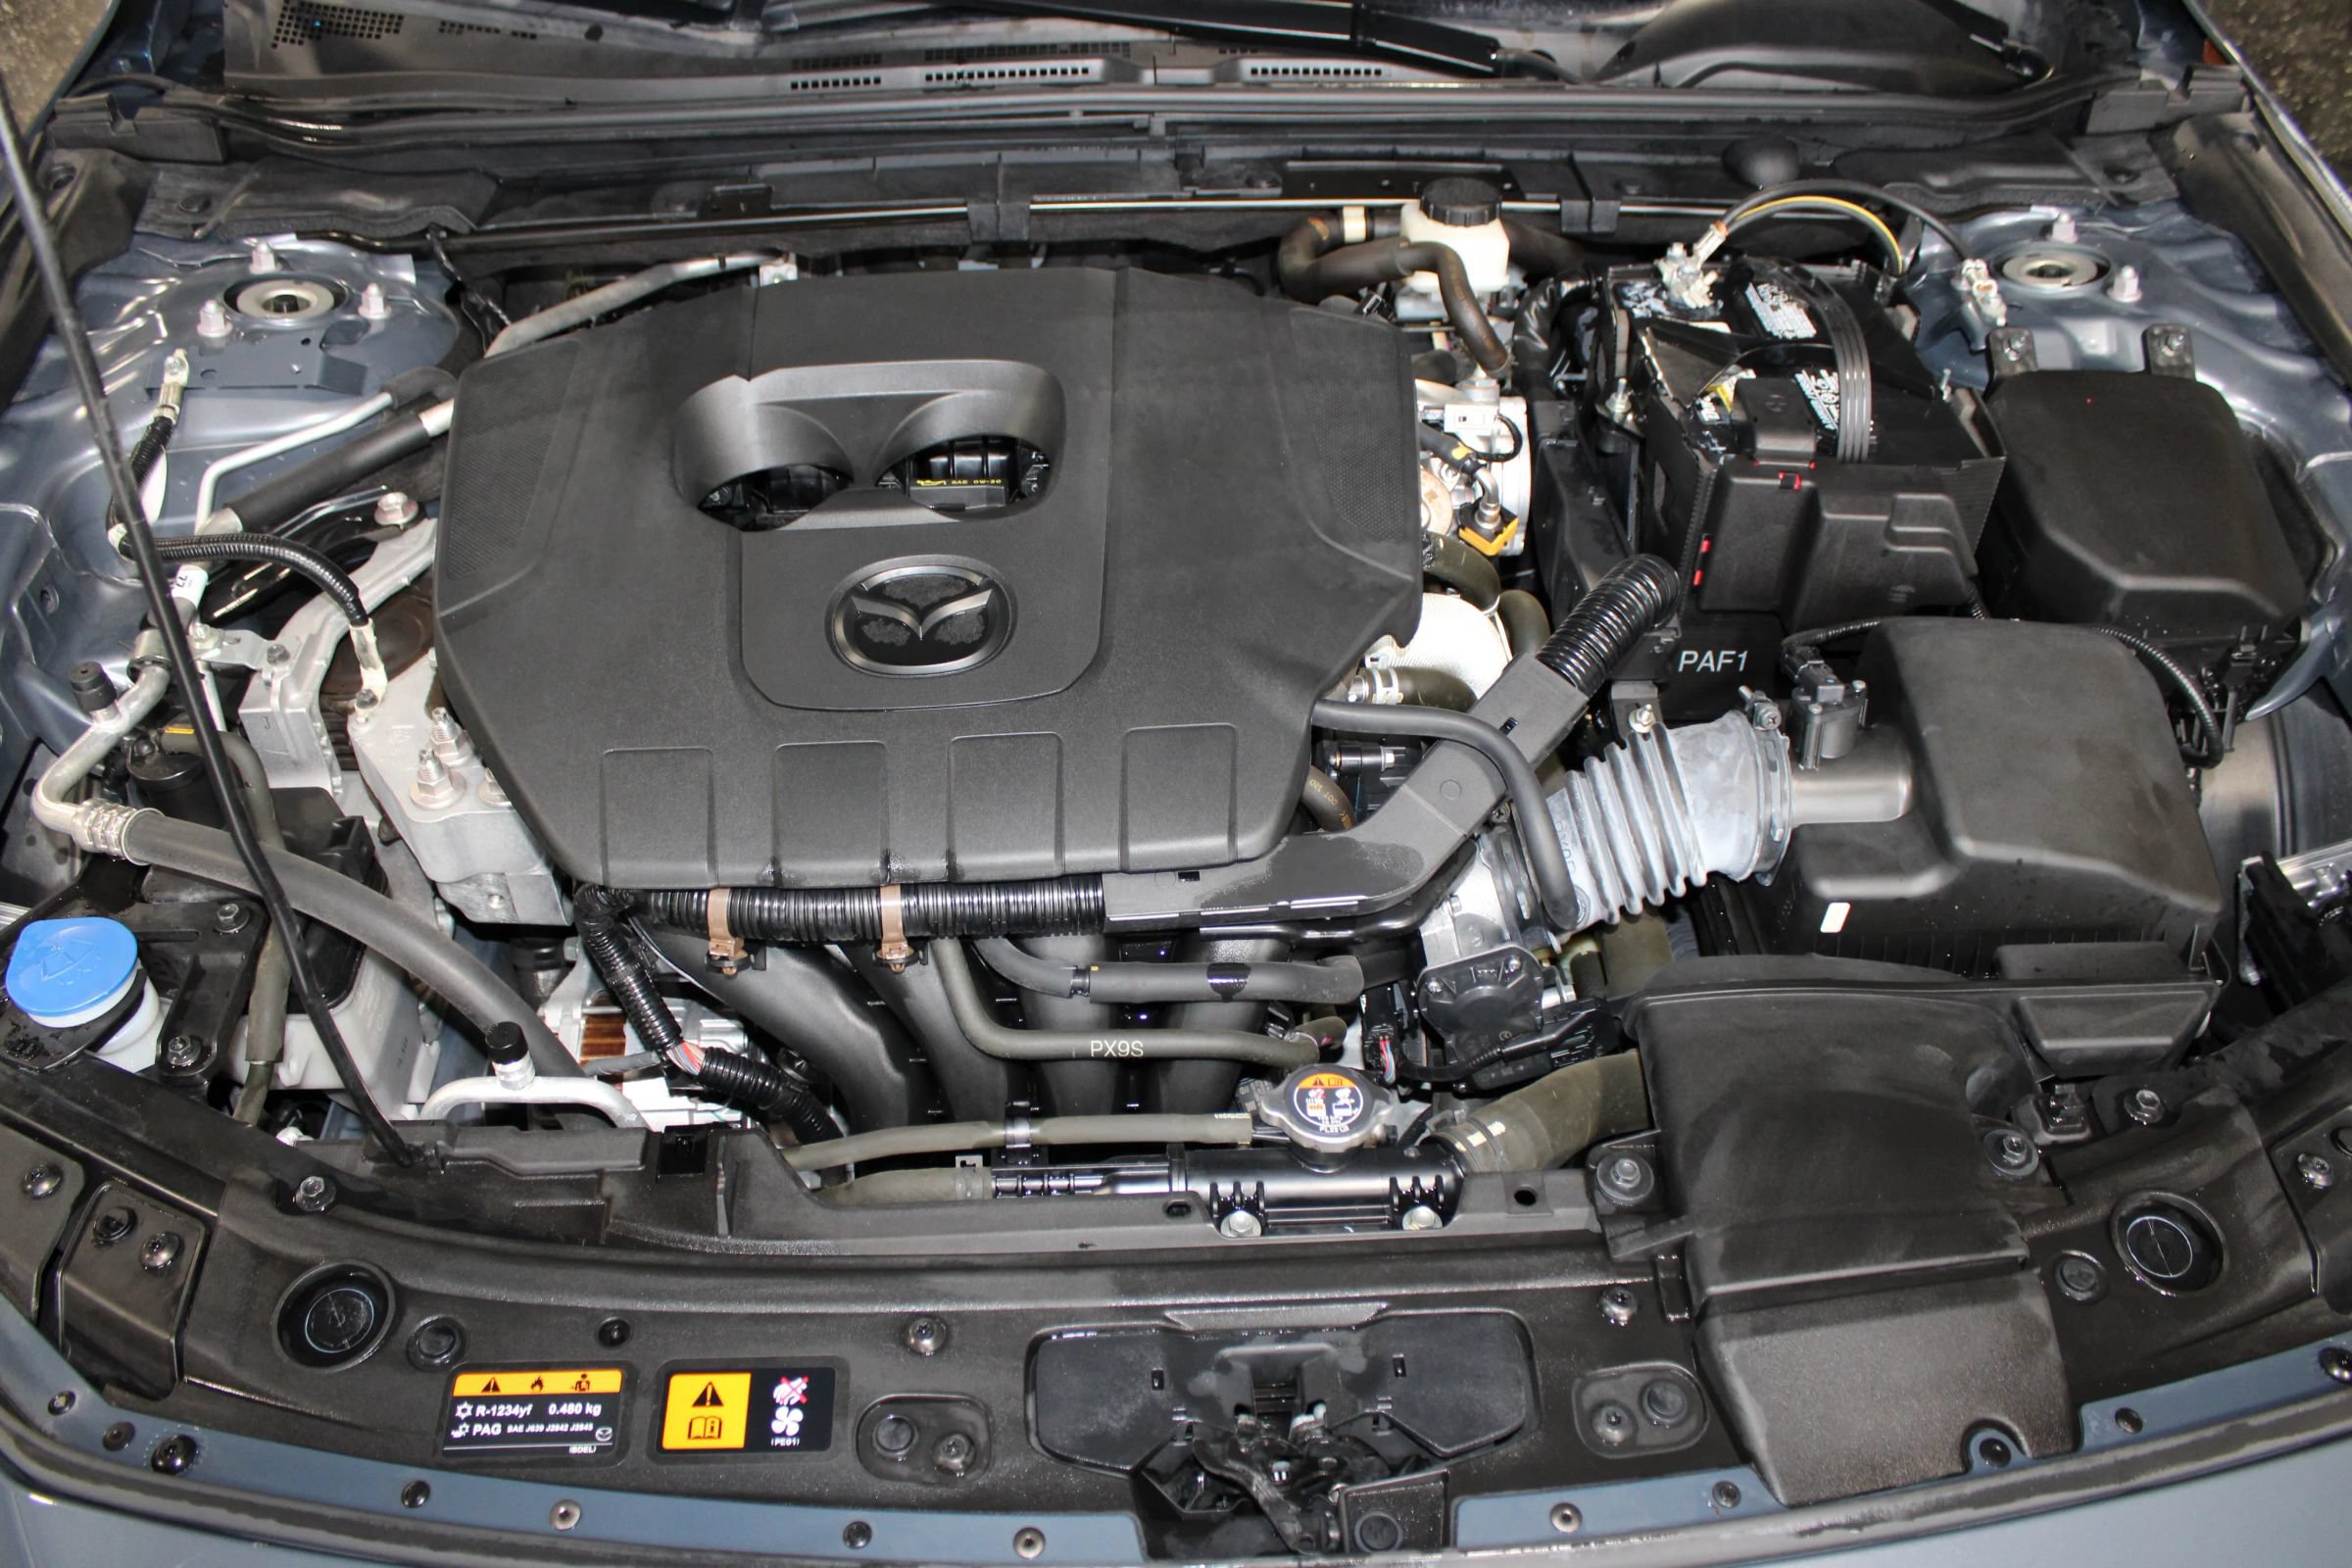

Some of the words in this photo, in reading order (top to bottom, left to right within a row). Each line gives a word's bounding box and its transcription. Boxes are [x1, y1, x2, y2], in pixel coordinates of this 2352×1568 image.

[1678, 650, 1748, 672] PAF1
[1090, 1040, 1144, 1057] PX9S
[475, 1403, 533, 1418] R-1234yf
[548, 1402, 582, 1415] 0.480
[585, 1402, 602, 1417] kg
[472, 1423, 502, 1436] PAG
